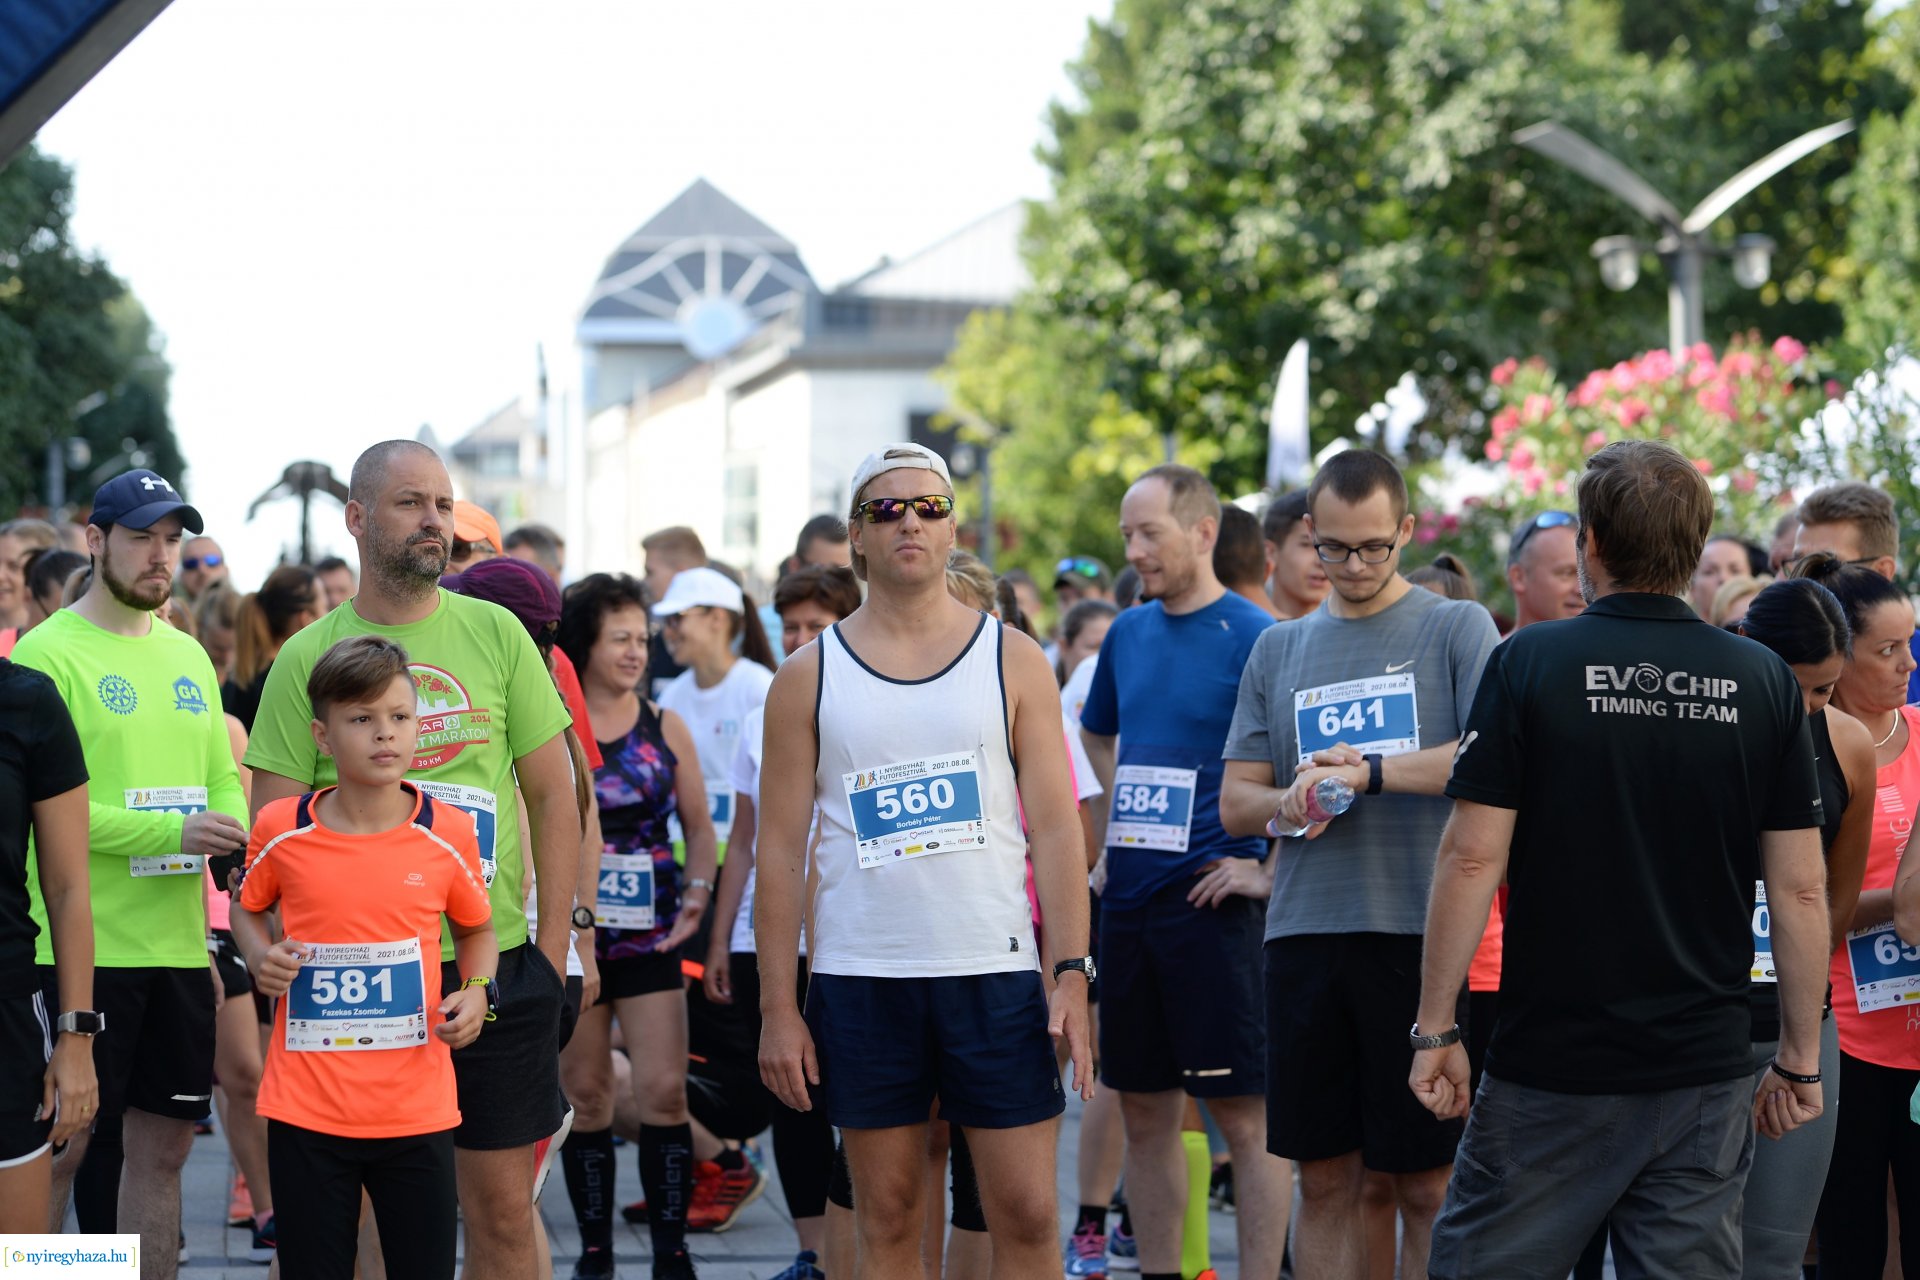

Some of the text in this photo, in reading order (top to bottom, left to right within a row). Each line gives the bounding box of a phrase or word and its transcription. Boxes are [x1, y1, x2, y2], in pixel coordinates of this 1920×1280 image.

[1318, 698, 1385, 736] 641
[1587, 696, 1738, 724] TIMING TEAM
[429, 728, 489, 744] MARATON
[429, 756, 442, 765] KM
[876, 778, 955, 820] 560
[1117, 784, 1169, 814] 584
[896, 814, 942, 829] Borbély Péter
[310, 967, 393, 1005] 581
[321, 1007, 387, 1017] Fazekas Zsombor
